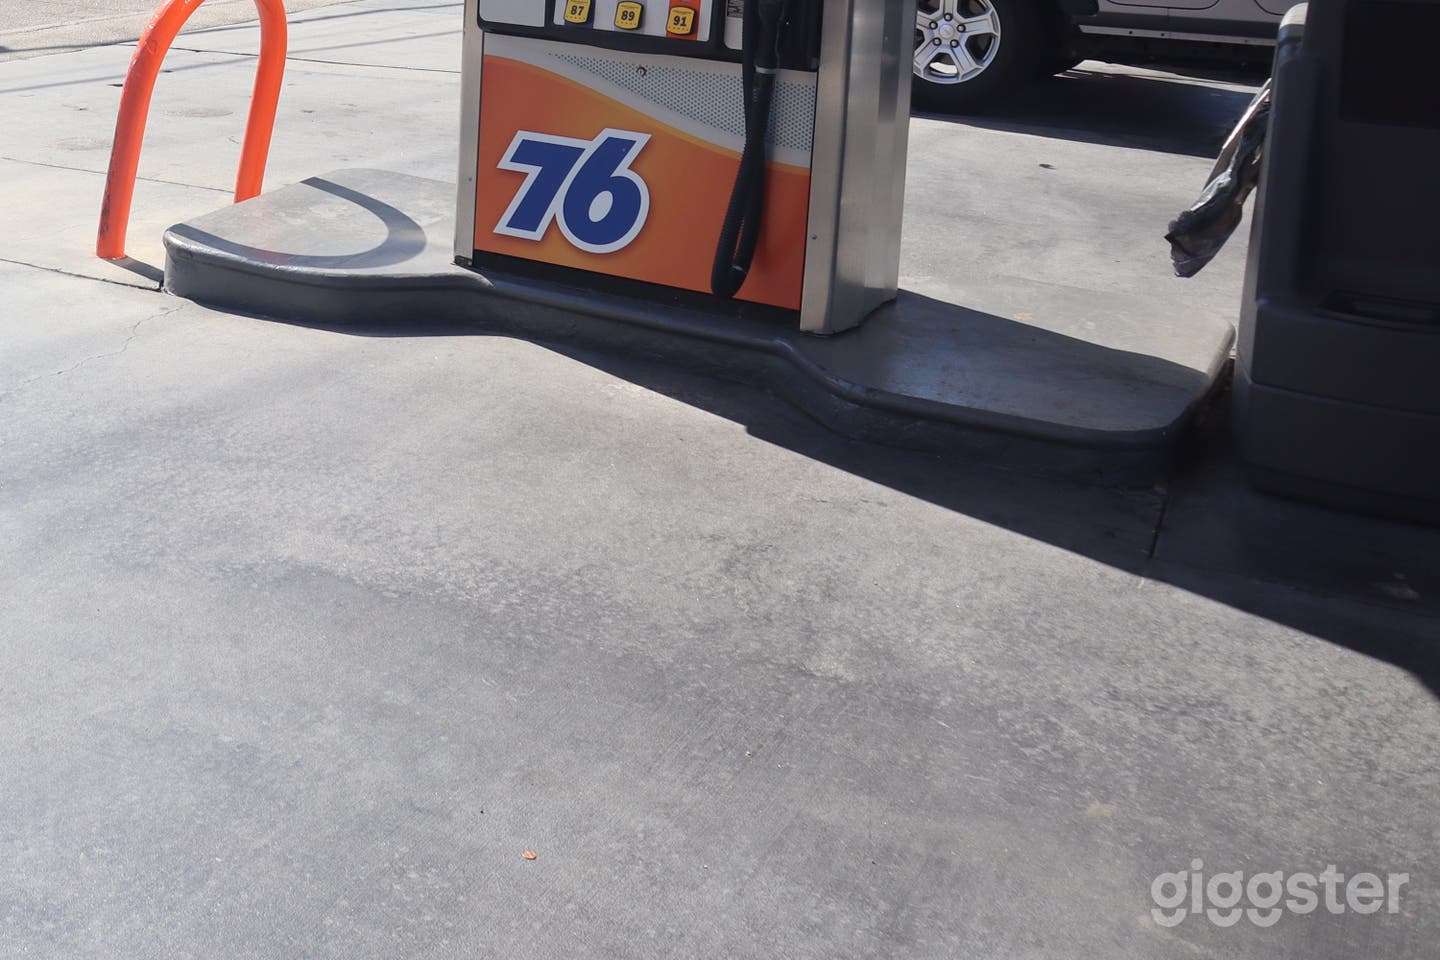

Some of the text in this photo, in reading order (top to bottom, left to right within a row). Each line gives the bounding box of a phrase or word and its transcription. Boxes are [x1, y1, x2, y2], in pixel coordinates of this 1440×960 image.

[570, 5, 584, 16] 87
[621, 10, 635, 21] 89
[673, 16, 687, 27] 91
[492, 128, 652, 254] 76
